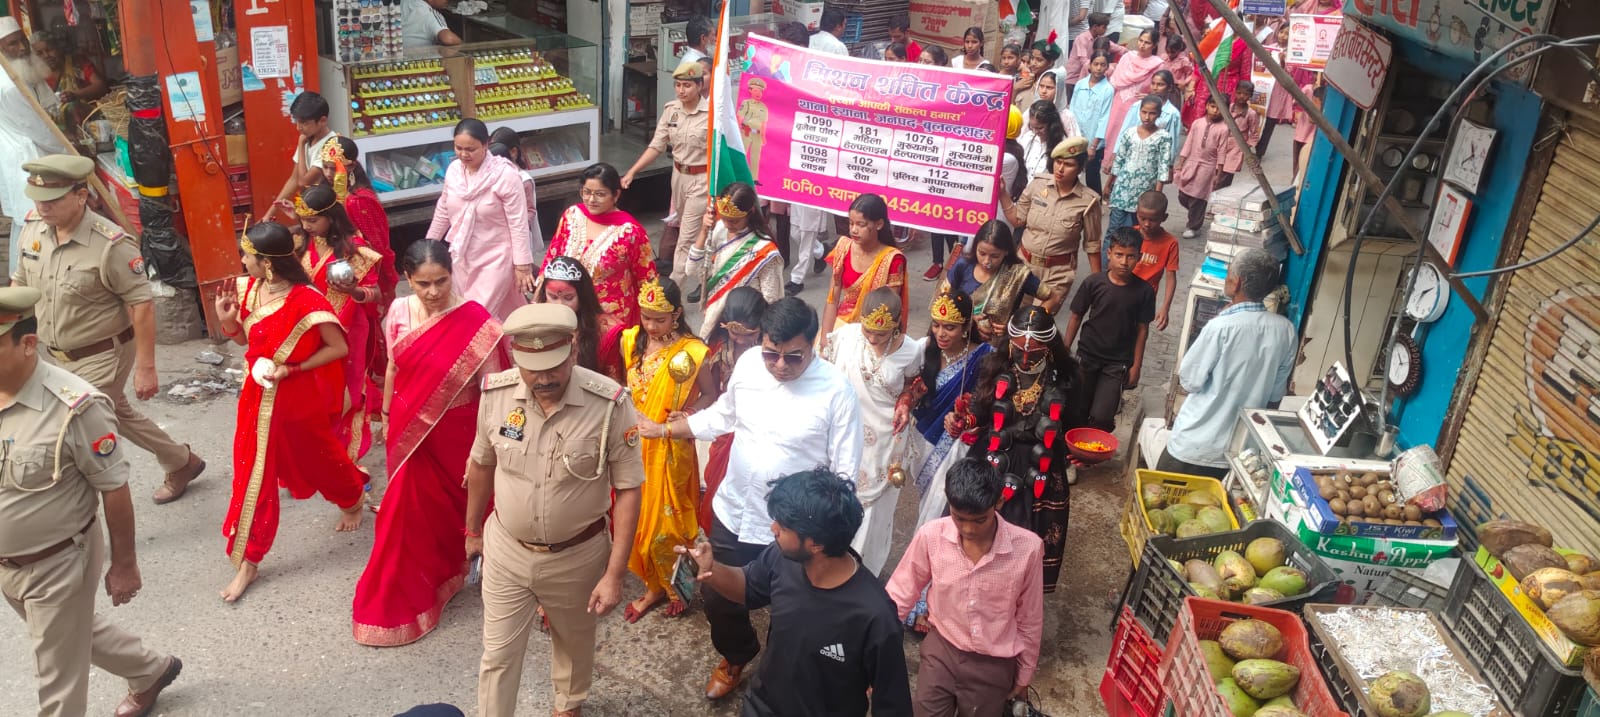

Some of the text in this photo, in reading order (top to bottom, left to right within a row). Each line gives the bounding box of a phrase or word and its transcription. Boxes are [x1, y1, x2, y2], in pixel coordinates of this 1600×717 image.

[803, 60, 1007, 111] मिशन शक्ति केन्द्र
[798, 99, 829, 114] थाना
[806, 115, 832, 128] 1090
[858, 126, 878, 137] 181
[853, 133, 882, 146] महिला
[905, 132, 934, 145] 1076
[801, 145, 828, 158] 1098
[961, 143, 983, 154] 108
[800, 161, 826, 173] लाइन
[852, 155, 874, 167] 102
[892, 171, 919, 183] पुलिस
[928, 168, 949, 180] 112
[820, 649, 846, 662] adidas
